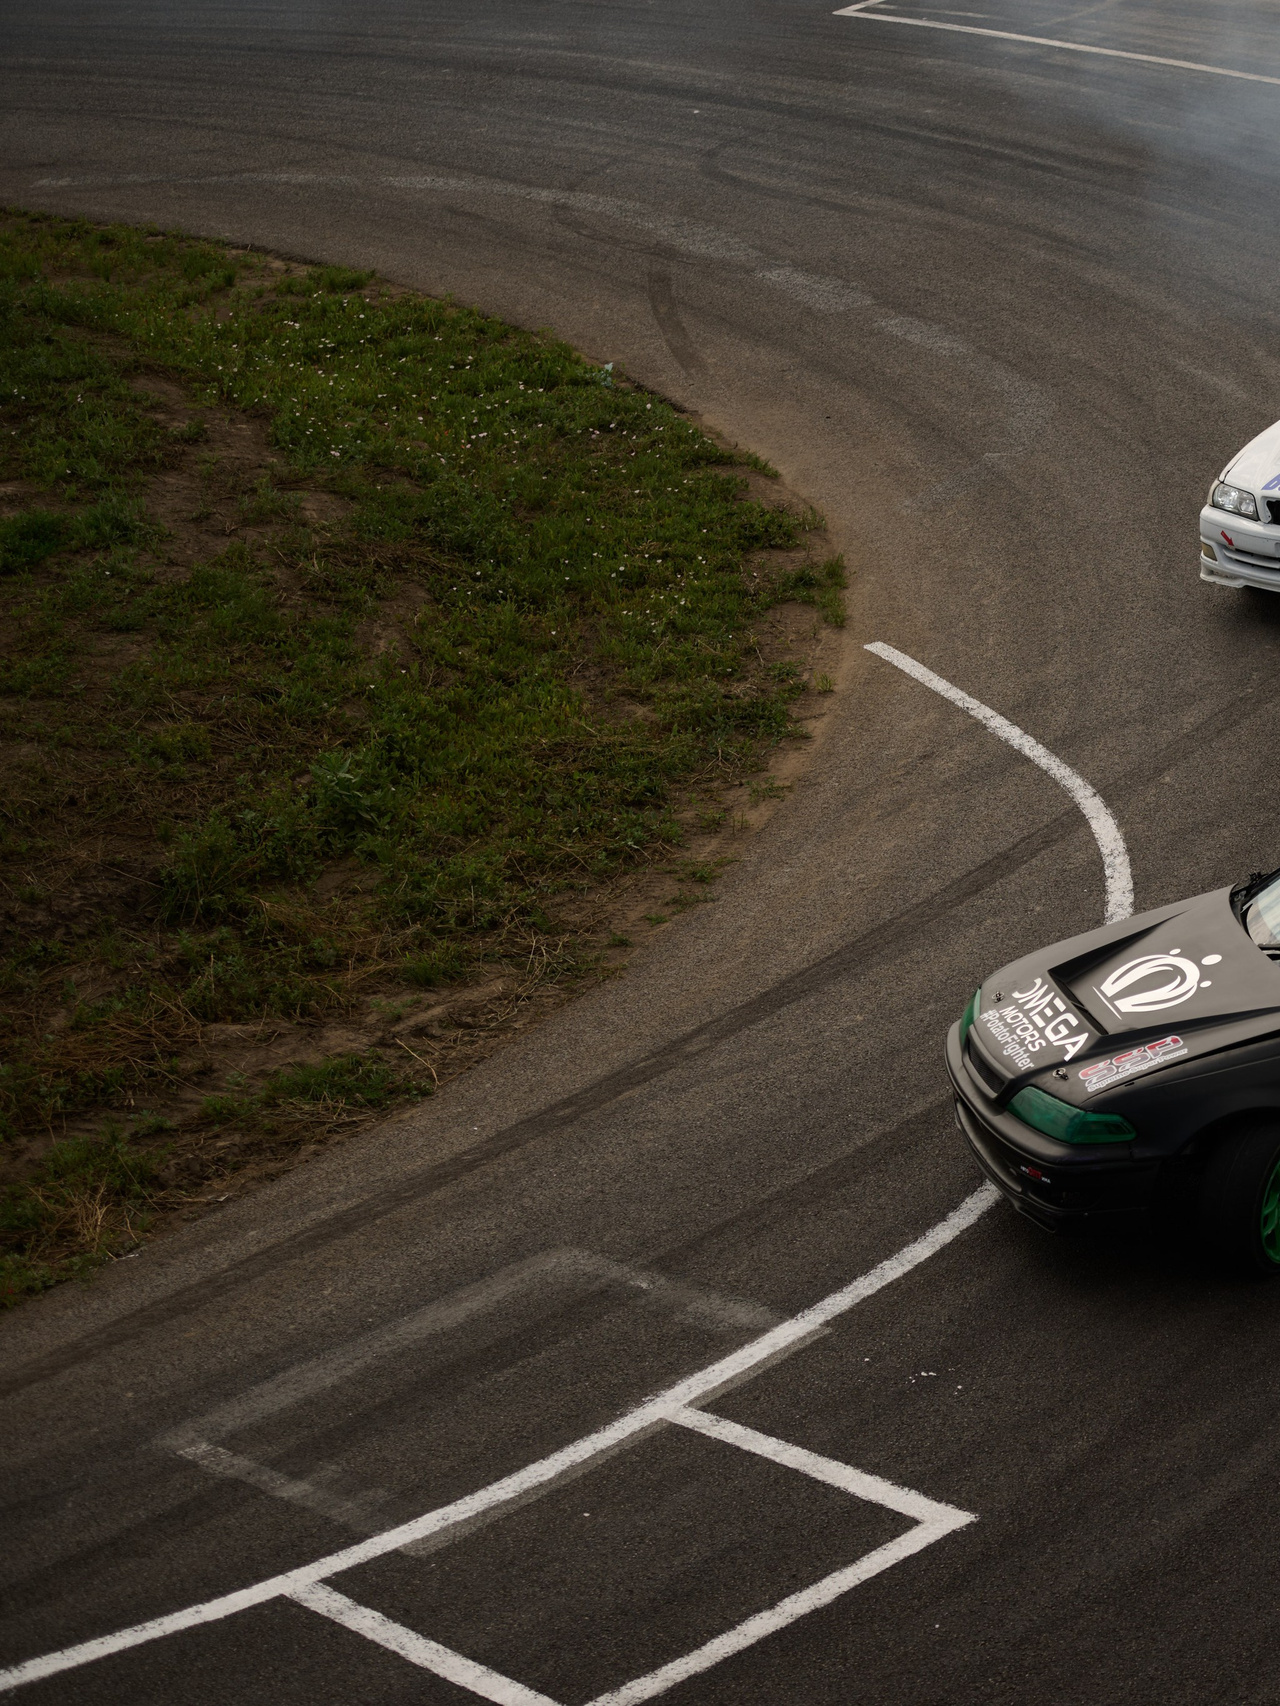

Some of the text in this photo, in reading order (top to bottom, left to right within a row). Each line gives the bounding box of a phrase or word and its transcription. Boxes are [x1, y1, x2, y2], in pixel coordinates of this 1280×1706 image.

[980, 1008, 1035, 1071] #PotatoFighter
[999, 1005, 1047, 1052] MOTORS
[1078, 1035, 1184, 1087] SSP
